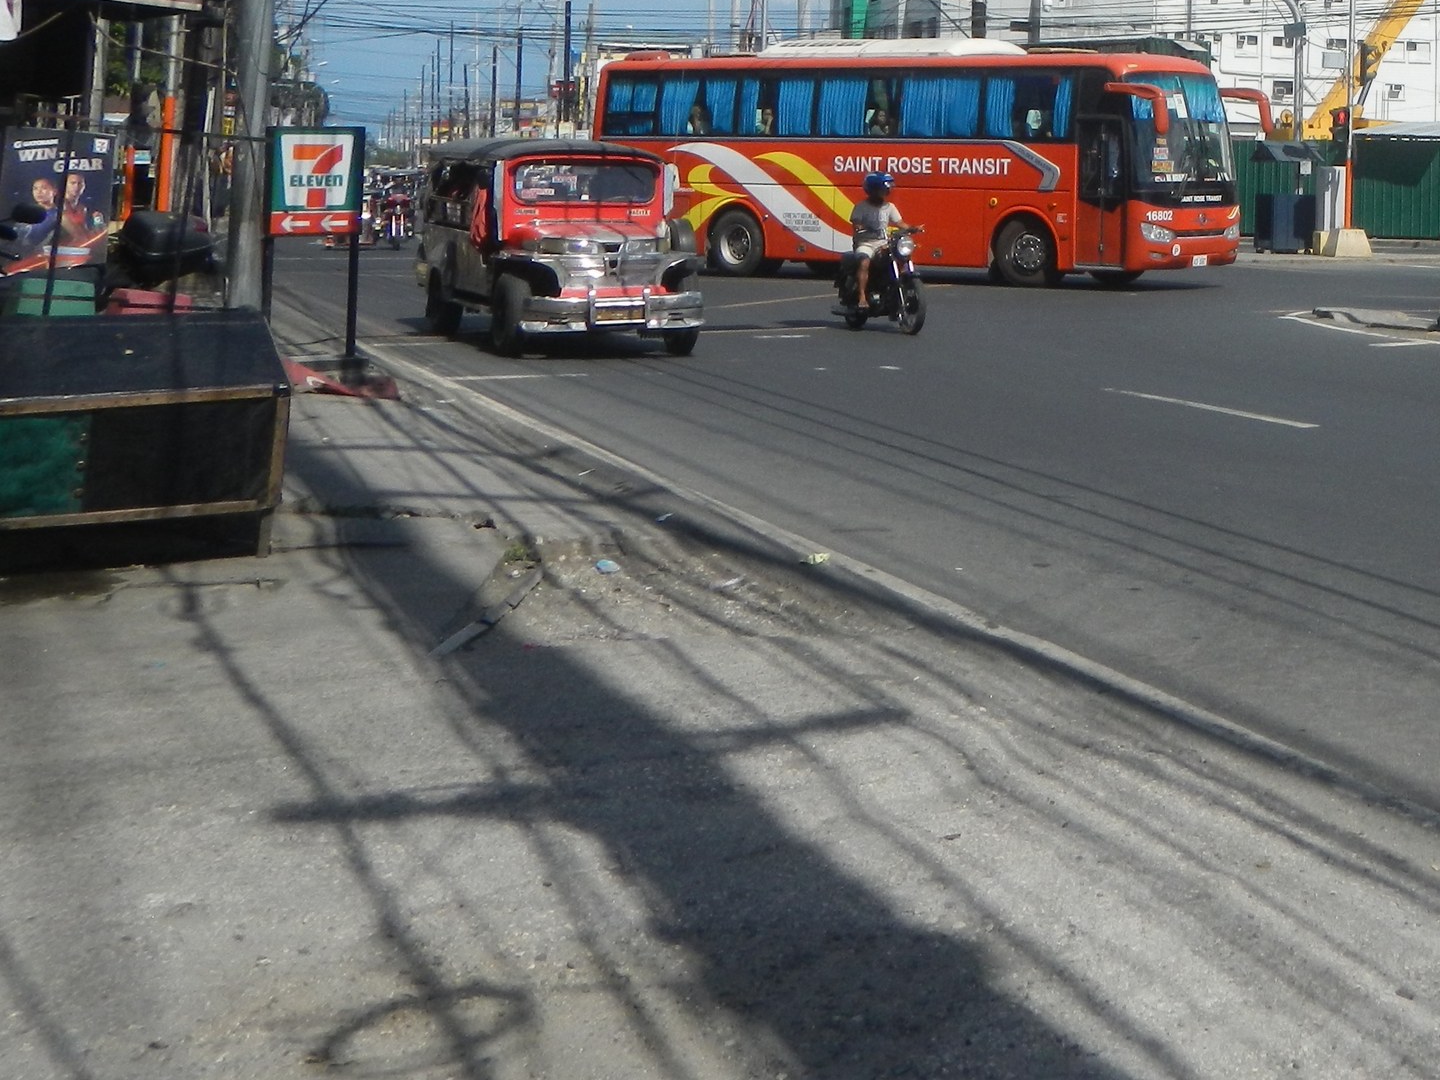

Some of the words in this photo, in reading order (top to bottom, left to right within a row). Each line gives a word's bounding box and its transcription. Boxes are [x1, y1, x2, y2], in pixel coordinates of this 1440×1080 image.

[18, 147, 57, 162] WIN
[53, 158, 103, 173] GEAR
[834, 155, 882, 173] SAINT
[887, 156, 932, 174] ROSE
[938, 157, 1011, 175] TRANSIT
[292, 143, 344, 208] 7
[1146, 210, 1173, 221] 16802
